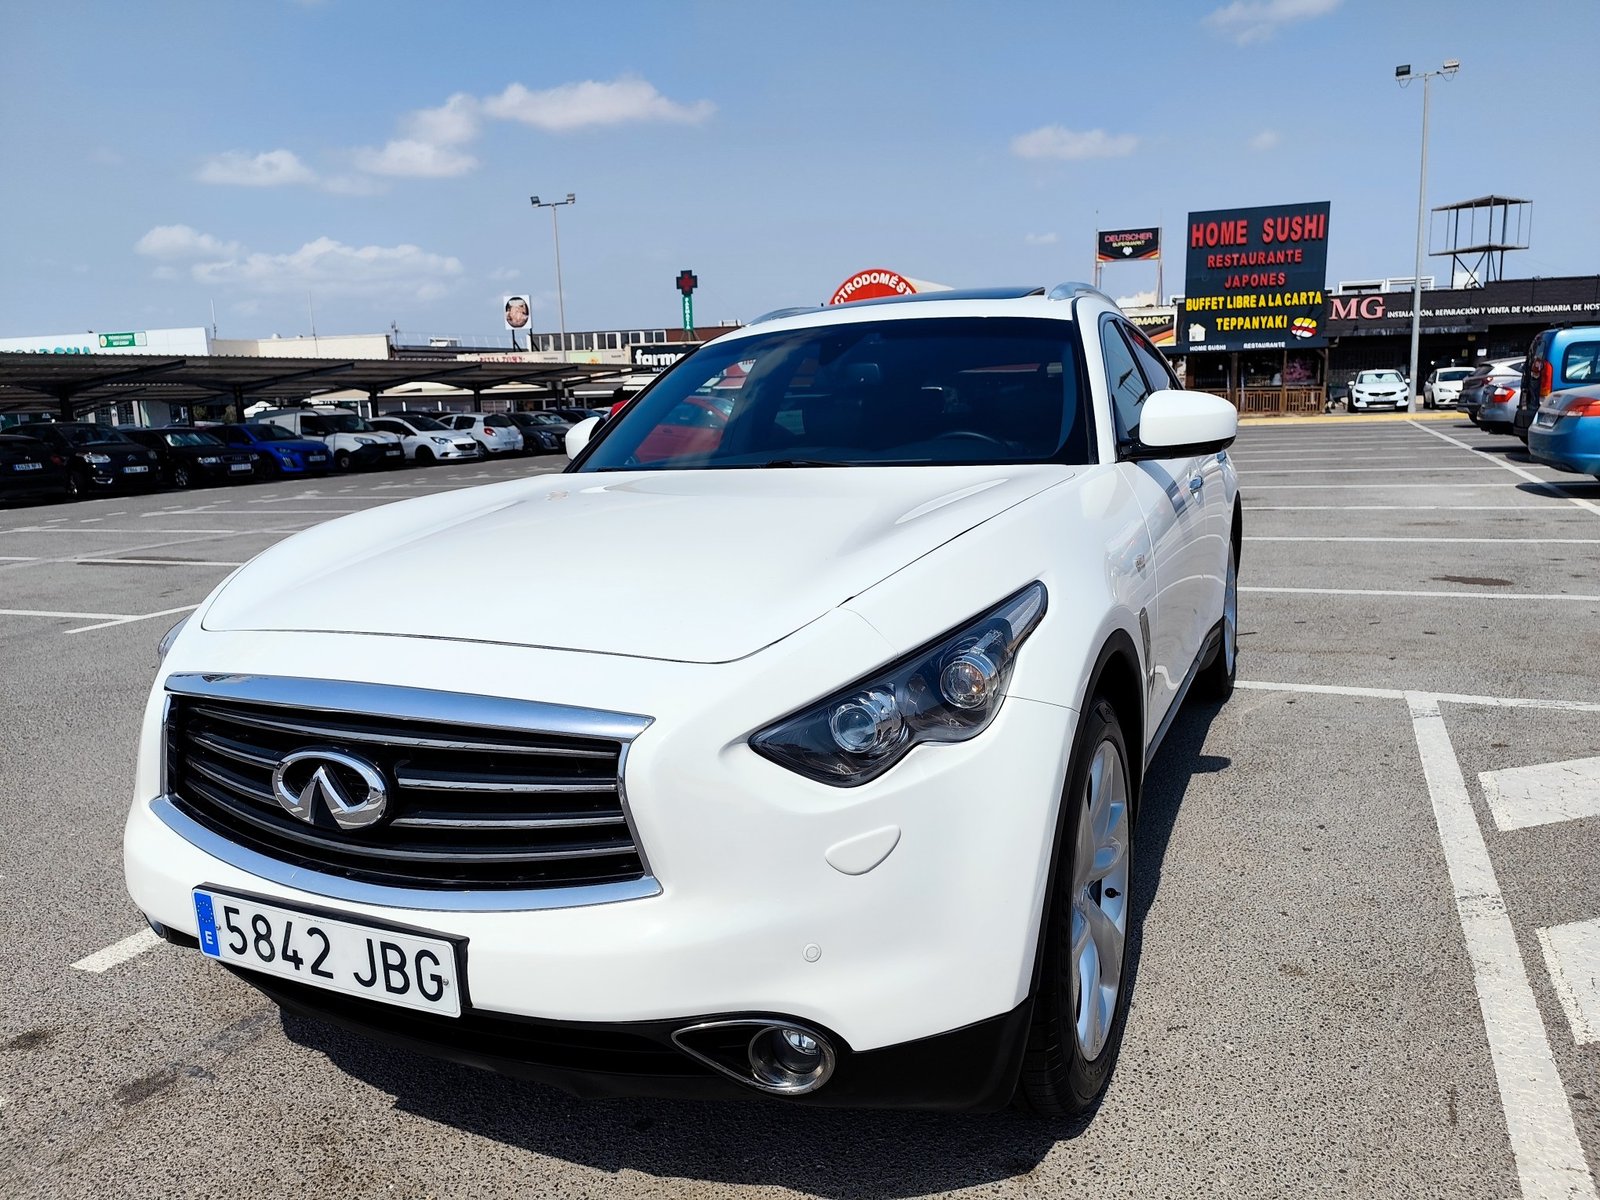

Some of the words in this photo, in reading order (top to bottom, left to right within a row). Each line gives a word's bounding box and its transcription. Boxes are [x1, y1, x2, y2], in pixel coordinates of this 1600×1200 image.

[1104, 232, 1153, 243] DEUTSCHER
[1191, 219, 1248, 248] HOME
[1262, 213, 1326, 244] SUSHI
[1207, 249, 1303, 269] RESTAURANTE
[1224, 272, 1286, 289] JAPONES
[1185, 298, 1225, 312] BUFFET
[1226, 296, 1257, 310] LIBRE
[1258, 295, 1267, 308] A
[1268, 294, 1283, 308] LA
[1284, 291, 1323, 306] CARTA
[1329, 296, 1386, 320] MG
[1480, 306, 1486, 315] Y
[1487, 306, 1510, 314] VENTA
[1511, 305, 1521, 313] DE
[1522, 304, 1571, 314] MAQUINARIA
[1572, 303, 1582, 311] DE
[1216, 315, 1288, 331] TEPPANYAKI
[1243, 341, 1286, 349] RESTAURANTE
[205, 930, 213, 944] E
[223, 906, 334, 979] 5842
[353, 938, 445, 1001] JBG
